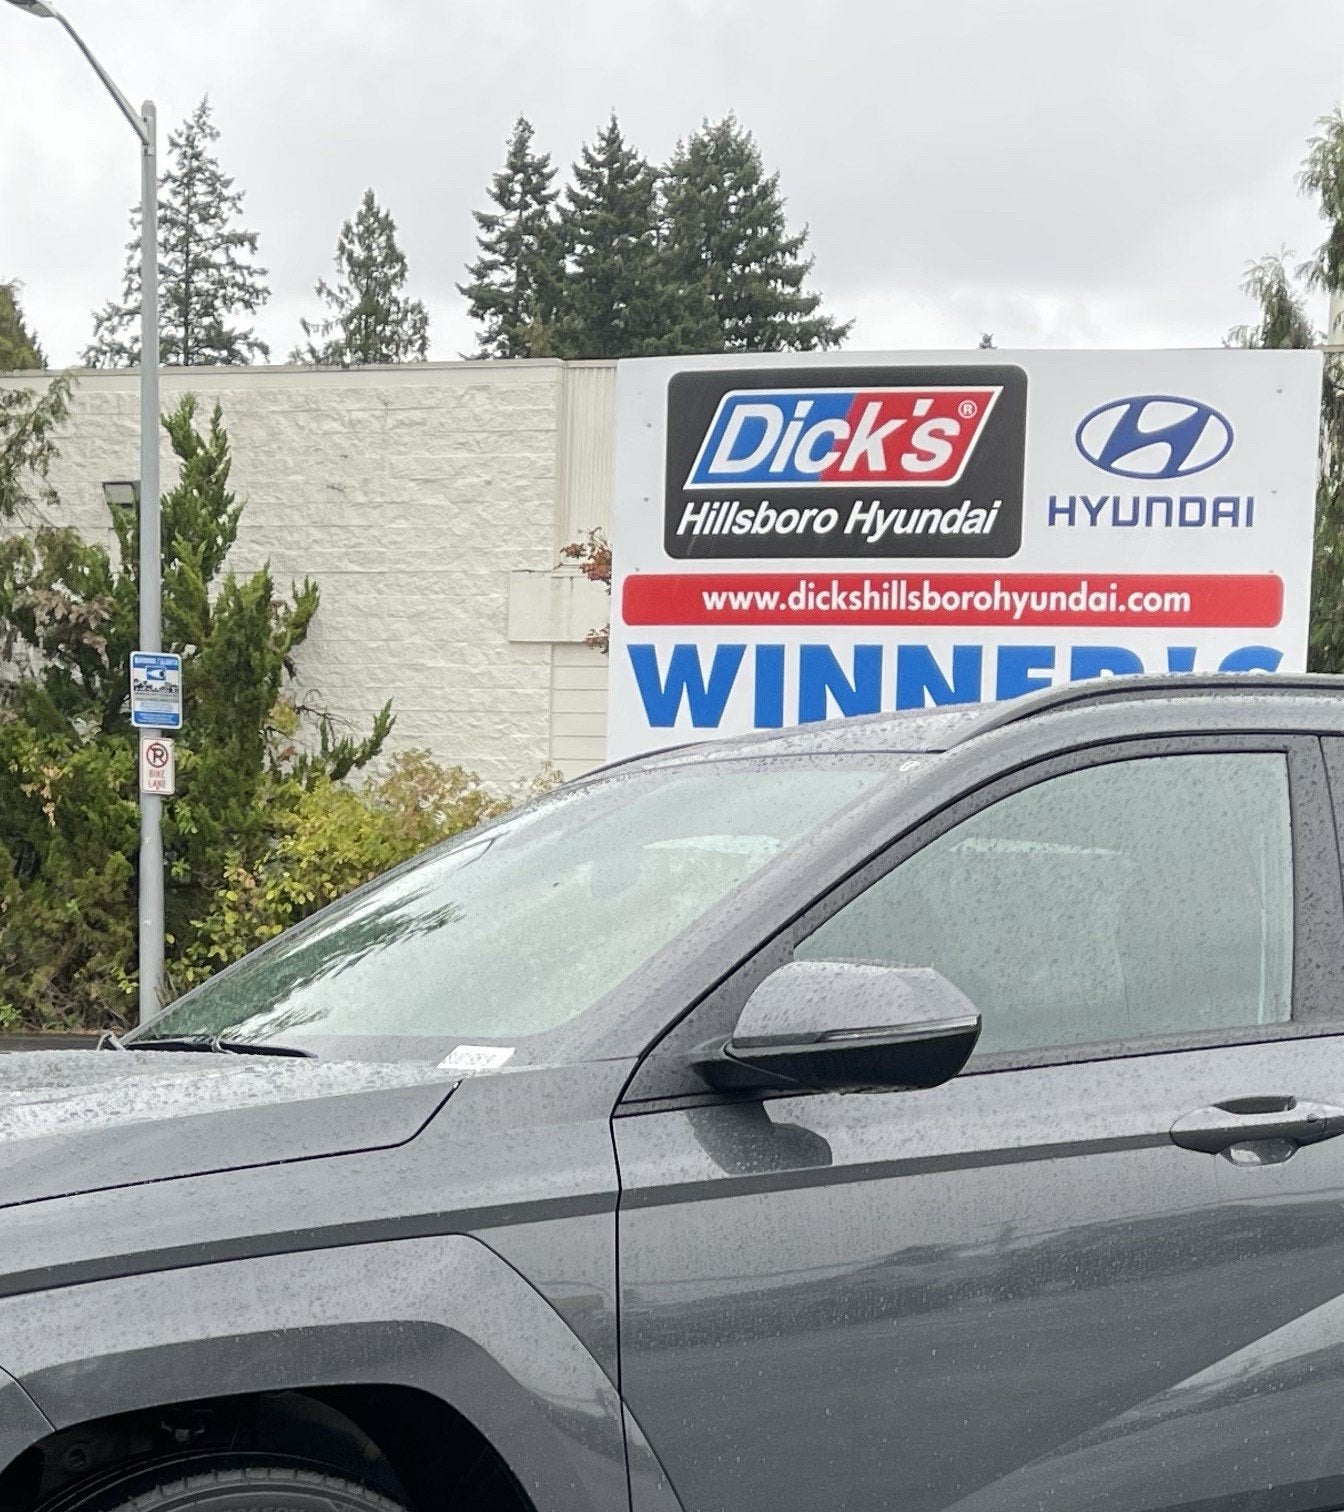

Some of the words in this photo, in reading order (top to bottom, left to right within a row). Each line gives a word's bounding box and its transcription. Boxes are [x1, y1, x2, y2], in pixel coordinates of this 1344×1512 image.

[708, 398, 961, 474] Dick's
[676, 501, 839, 536] Hillsboro
[843, 500, 1002, 543] Hyundai
[1048, 495, 1254, 527] HYUNDAI
[702, 579, 1191, 619] www.dickshillsborohyundai.com
